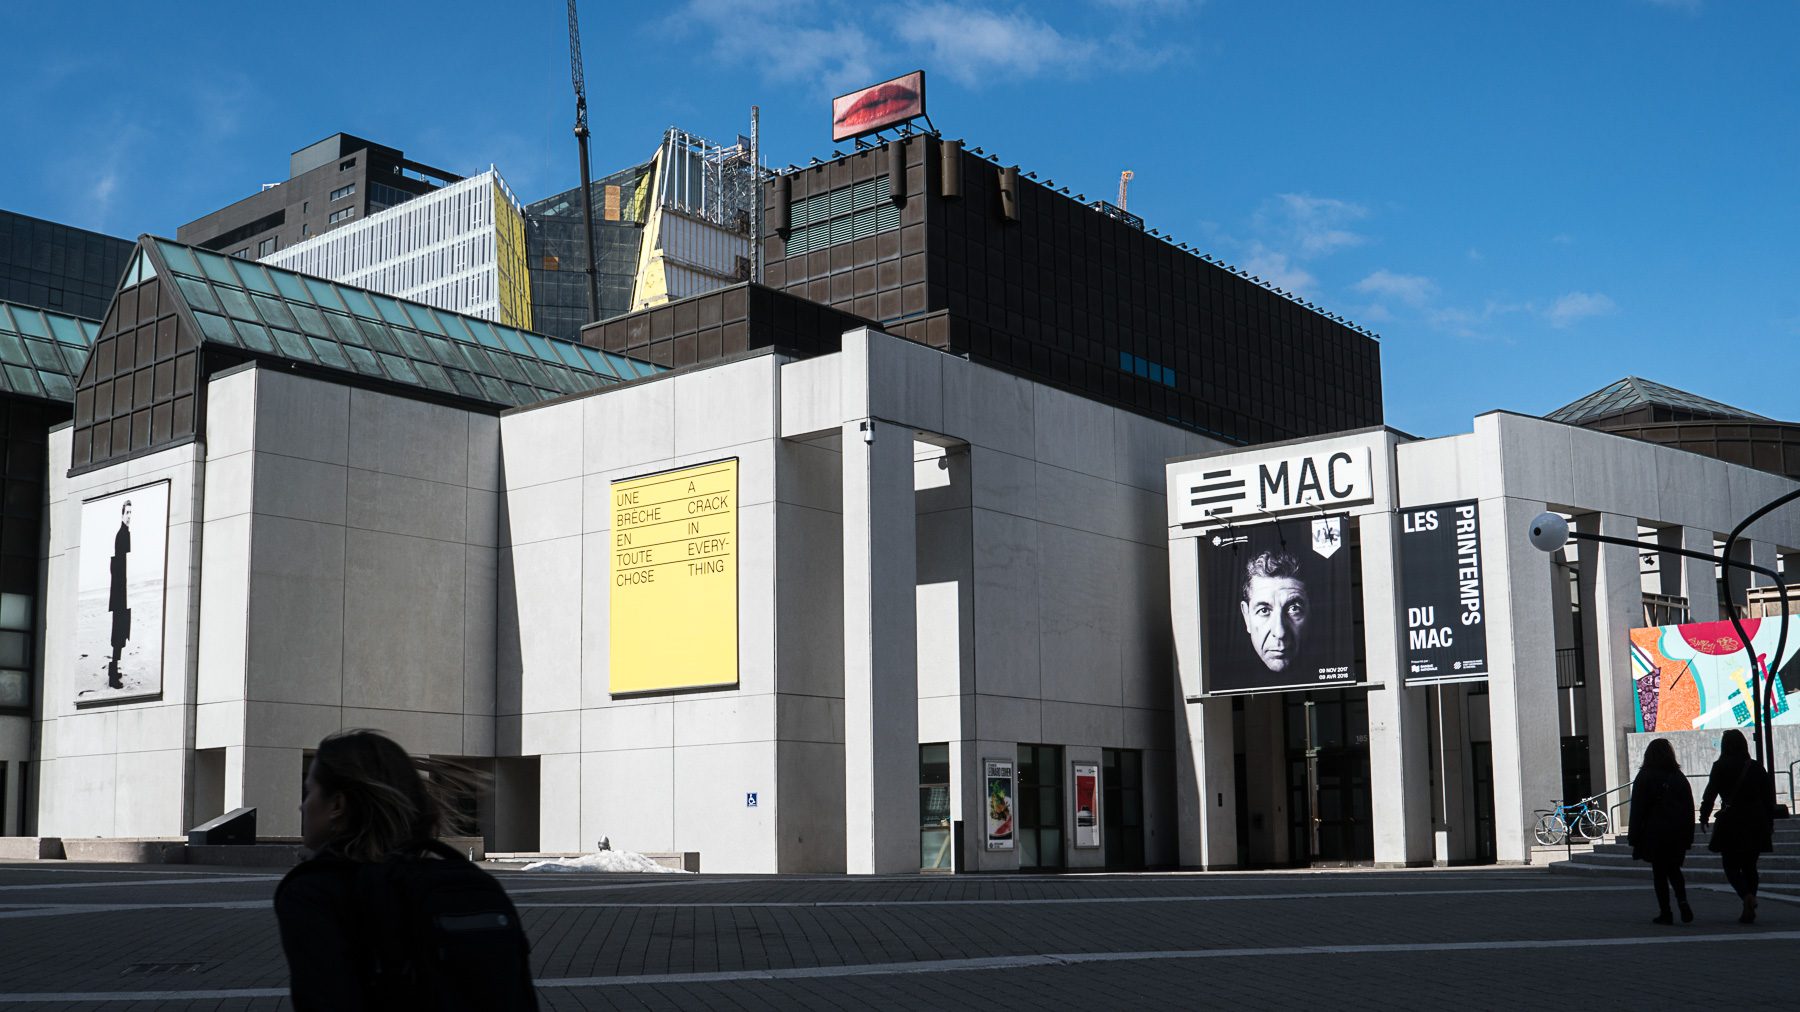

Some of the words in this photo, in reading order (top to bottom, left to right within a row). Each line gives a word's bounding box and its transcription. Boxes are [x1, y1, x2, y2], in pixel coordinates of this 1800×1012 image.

[687, 481, 696, 494] A
[1259, 452, 1354, 509] MAC
[616, 491, 640, 507] UNE
[687, 495, 729, 514] CRACK
[688, 521, 699, 535] IN
[1403, 510, 1439, 533] LES
[617, 533, 632, 547] EN
[688, 537, 730, 556] EVERY-
[616, 549, 653, 567] TOUTE
[1455, 505, 1482, 626] PRINTEMPS
[688, 559, 724, 577] THING
[616, 569, 655, 587] CHOSE
[1408, 606, 1435, 628] DU
[1409, 626, 1453, 650] MAC
